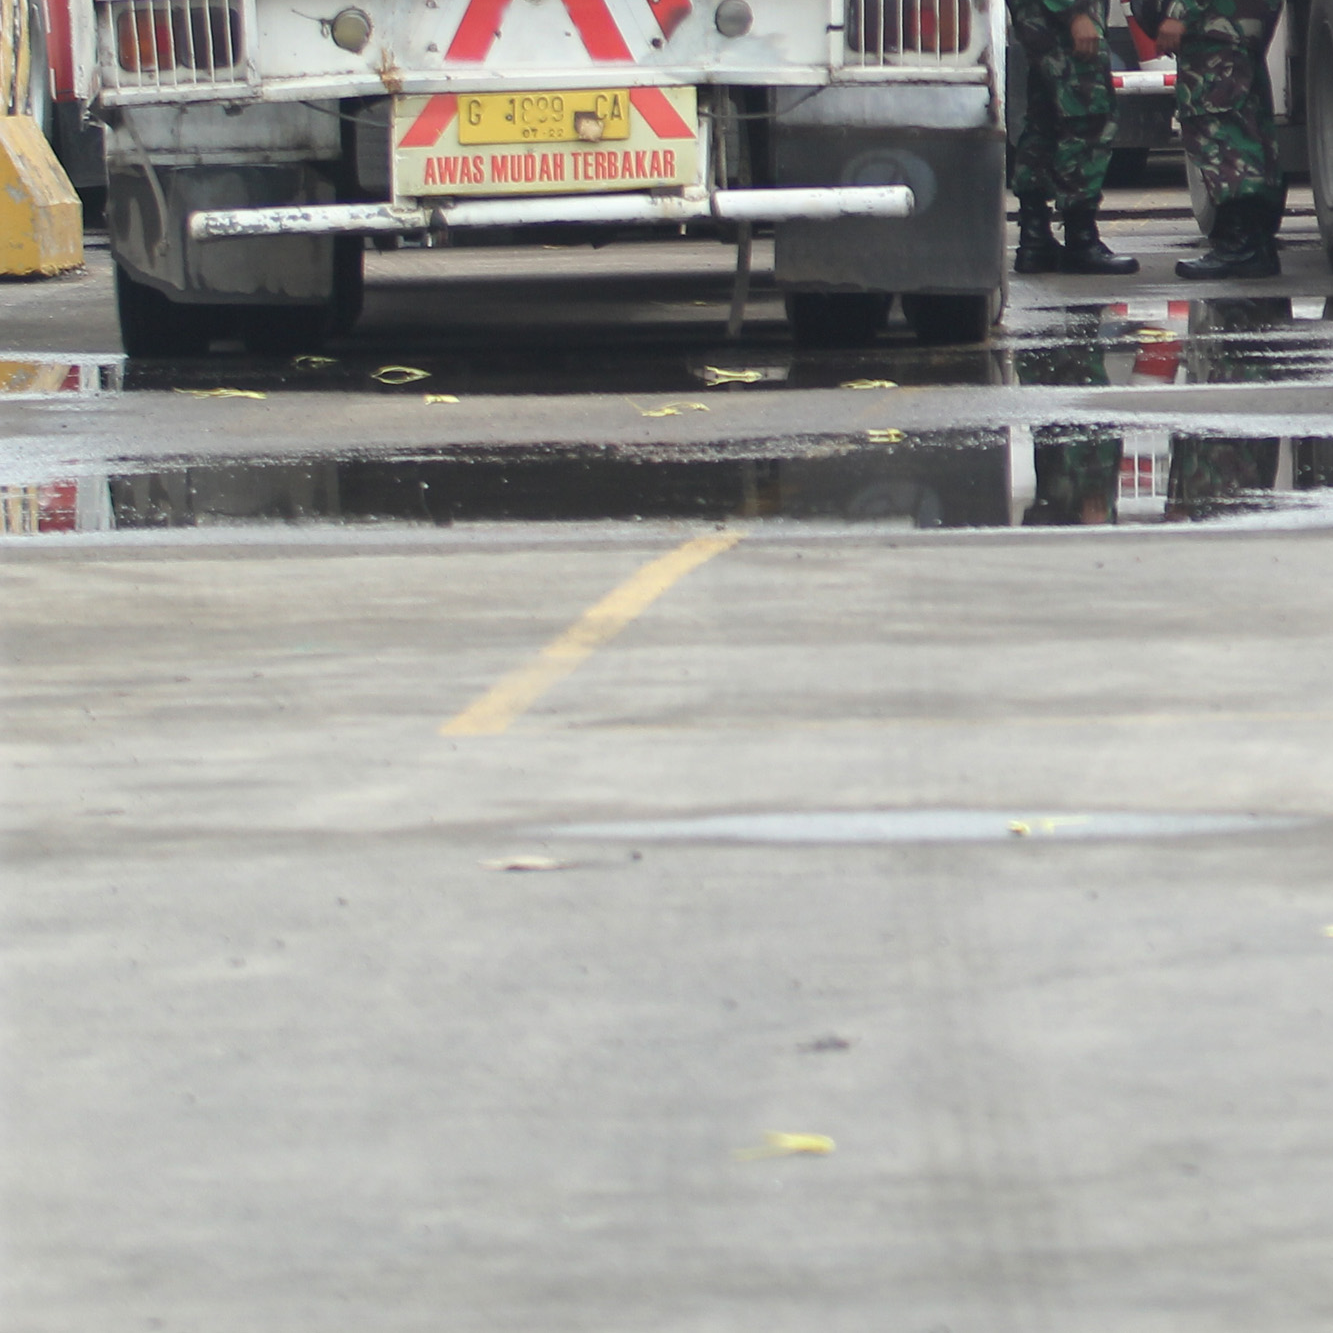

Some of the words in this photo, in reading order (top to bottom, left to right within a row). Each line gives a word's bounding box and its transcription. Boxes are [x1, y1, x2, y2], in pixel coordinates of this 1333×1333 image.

[468, 98, 482, 126] G
[594, 93, 625, 122] CA
[424, 155, 484, 185] AWAS
[491, 153, 565, 183] MUDAH
[572, 150, 676, 180] TERBAKAR
